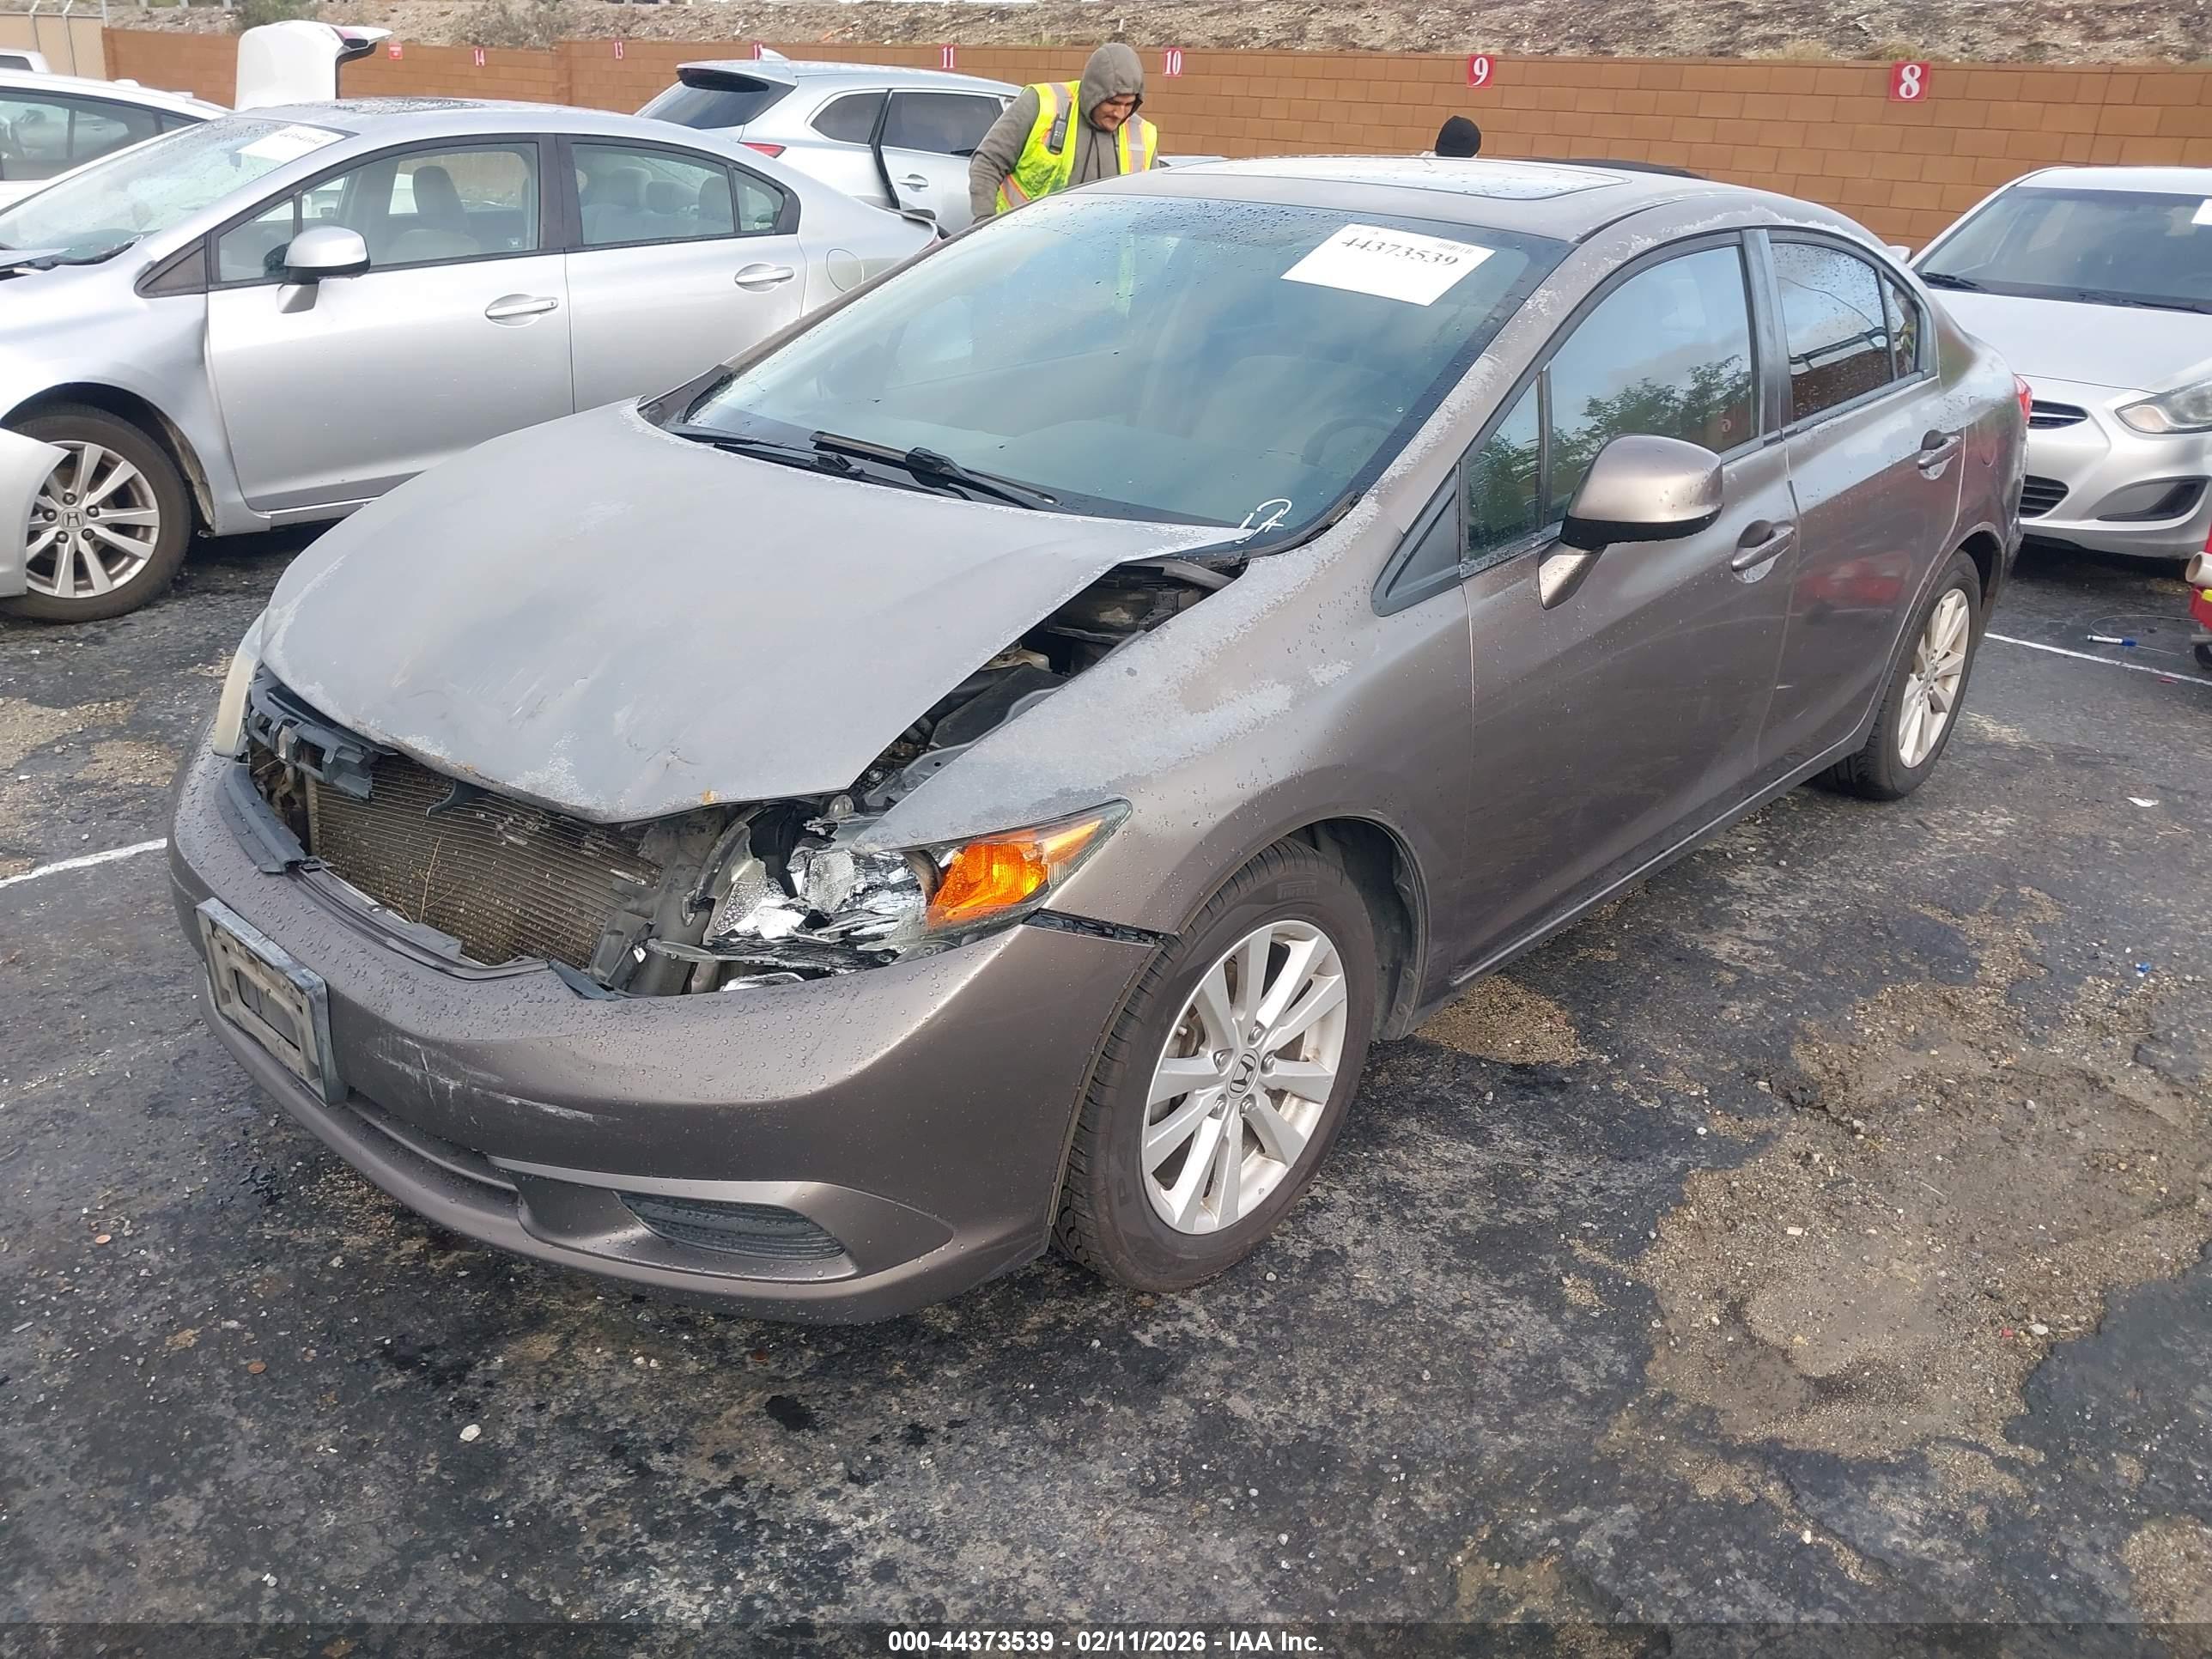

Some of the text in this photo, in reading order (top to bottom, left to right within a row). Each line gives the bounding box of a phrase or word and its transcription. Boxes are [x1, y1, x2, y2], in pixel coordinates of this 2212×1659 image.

[474, 49, 485, 66] 14
[614, 41, 624, 60] 13
[942, 46, 955, 69] 11
[1164, 50, 1182, 76] 10
[1472, 57, 1490, 87] 9
[1899, 64, 1922, 100] 8
[1340, 237, 1459, 266] 44373539
